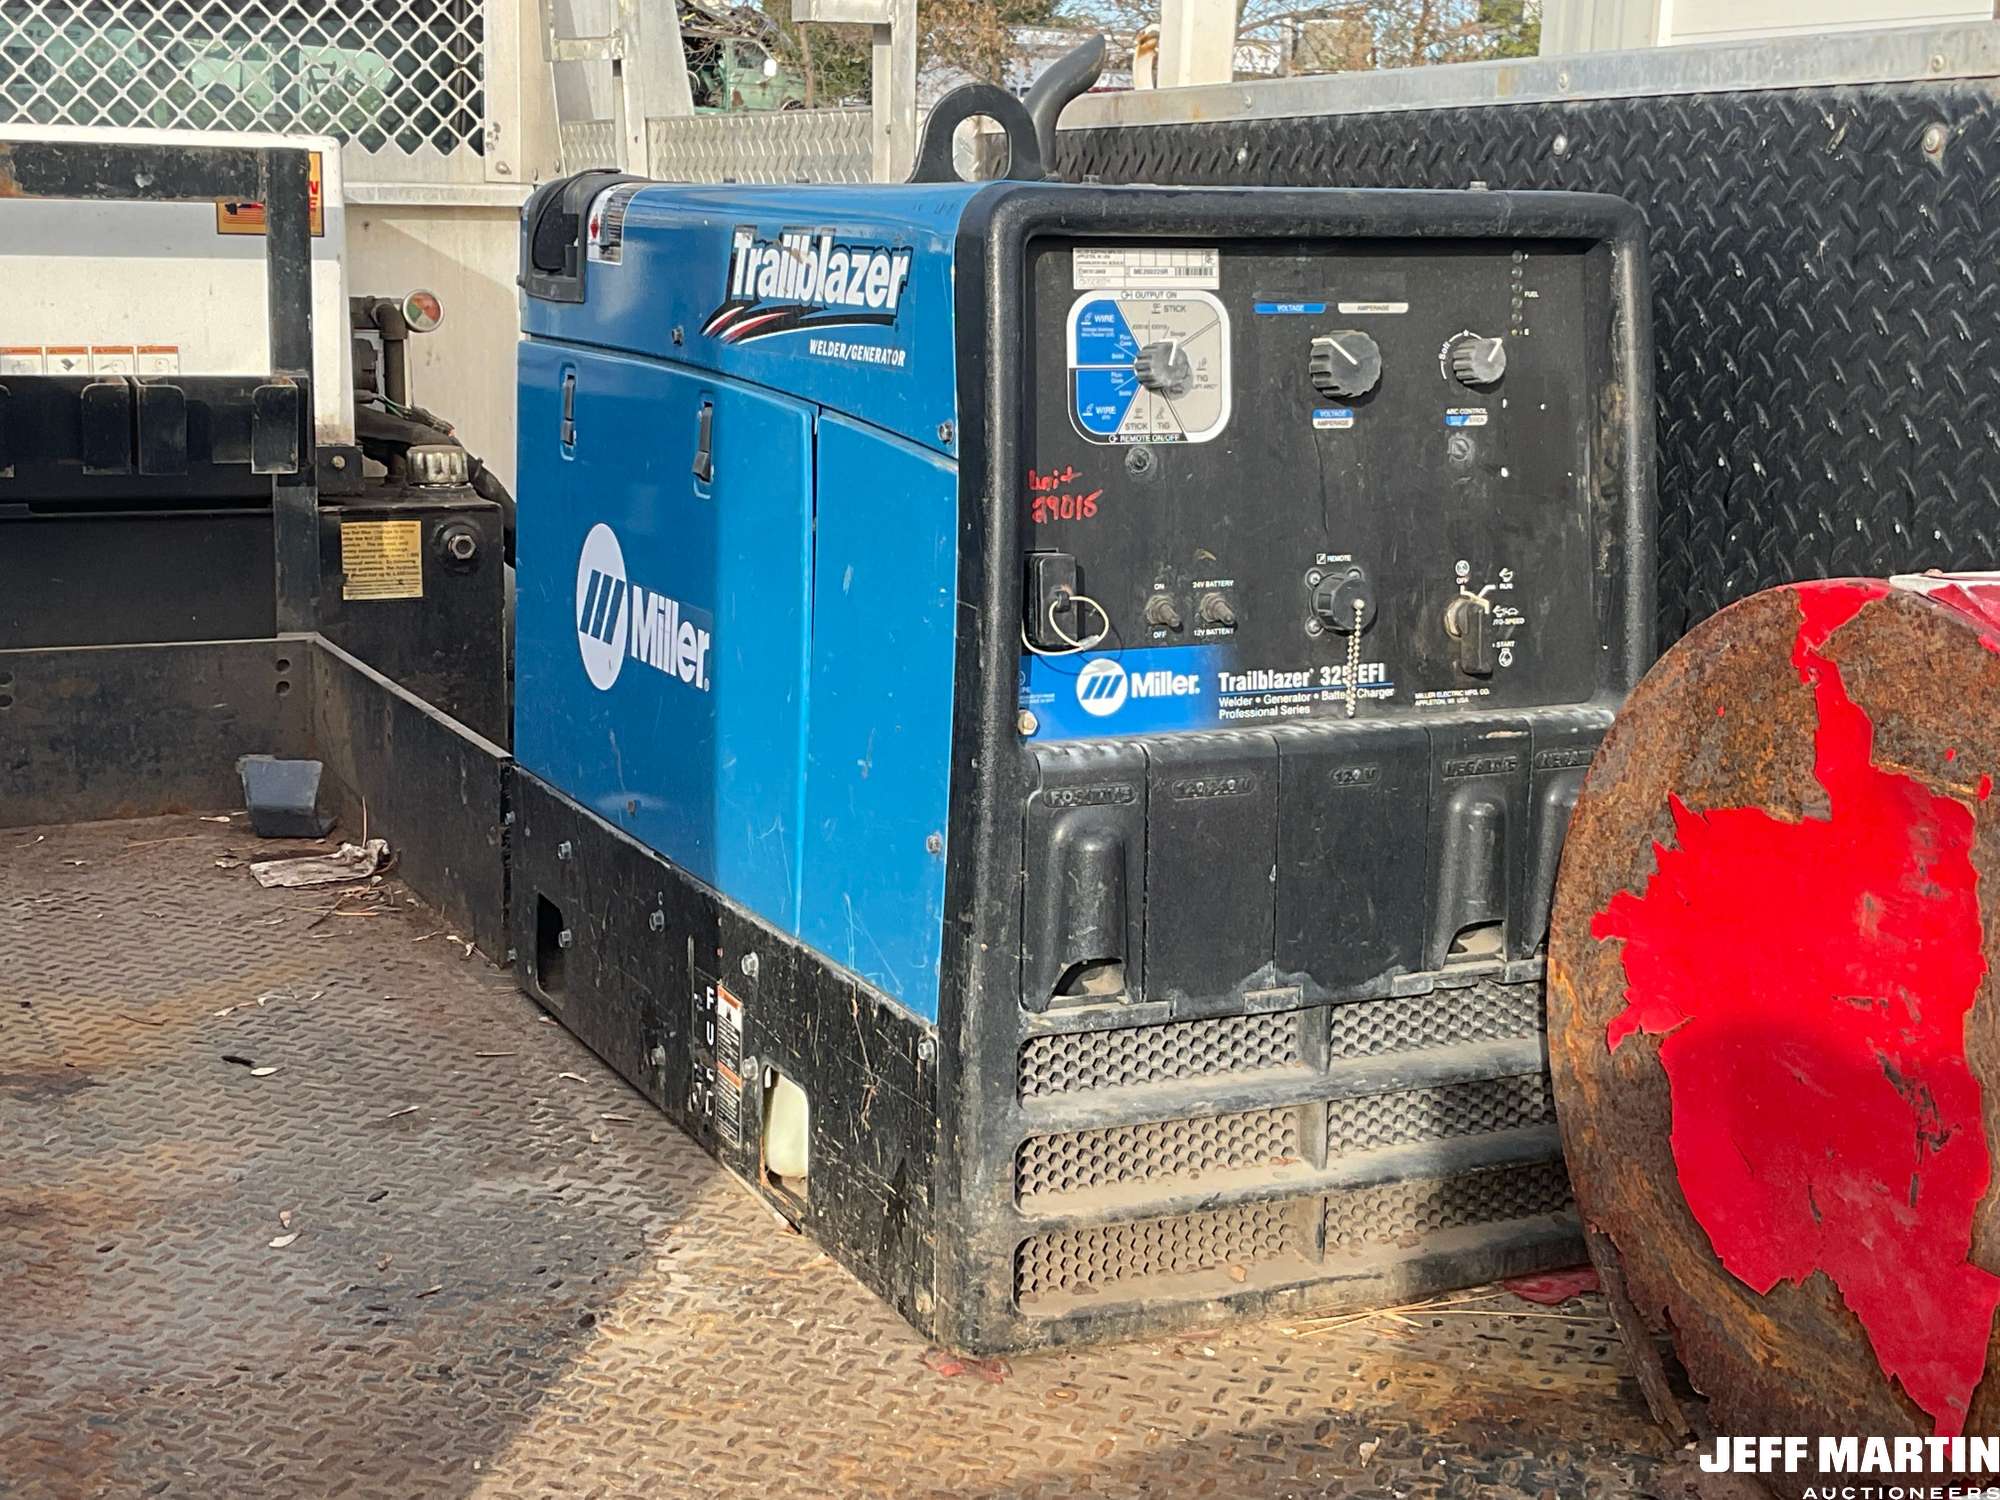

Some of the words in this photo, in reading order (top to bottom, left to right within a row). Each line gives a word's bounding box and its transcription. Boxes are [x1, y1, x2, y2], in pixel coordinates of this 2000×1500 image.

[731, 231, 911, 310] Trailblazer
[1135, 291, 1164, 299] OUTPUT
[1166, 291, 1178, 299] ON
[1524, 290, 1540, 298] FUEL
[1163, 304, 1187, 313] STICK
[1276, 304, 1305, 312] VOLTAGE
[1357, 304, 1390, 312] AMPERAGE
[1094, 314, 1115, 323] WIRE
[809, 338, 907, 367] WELDER/GENERATOR
[1196, 374, 1209, 382] TIG
[1095, 406, 1117, 415] WIRE
[1125, 422, 1148, 431] STICK
[1157, 422, 1171, 431] TIG
[1120, 434, 1151, 442] REMOTE
[1151, 434, 1181, 442] ON/OFF
[1327, 554, 1352, 562] REMOTE
[1192, 581, 1205, 589] 24V
[1205, 579, 1235, 588] BATTERY
[1153, 630, 1168, 639] OFF
[1193, 629, 1206, 637] 12V
[1357, 663, 1385, 684] EFI
[1218, 696, 1253, 708] Welder
[1263, 693, 1311, 705] Generator
[1321, 690, 1347, 701] Batte
[1356, 688, 1395, 701] Charger
[1436, 690, 1464, 698] ELECTRIC
[1218, 706, 1279, 719] Professional
[1280, 704, 1311, 716] Series
